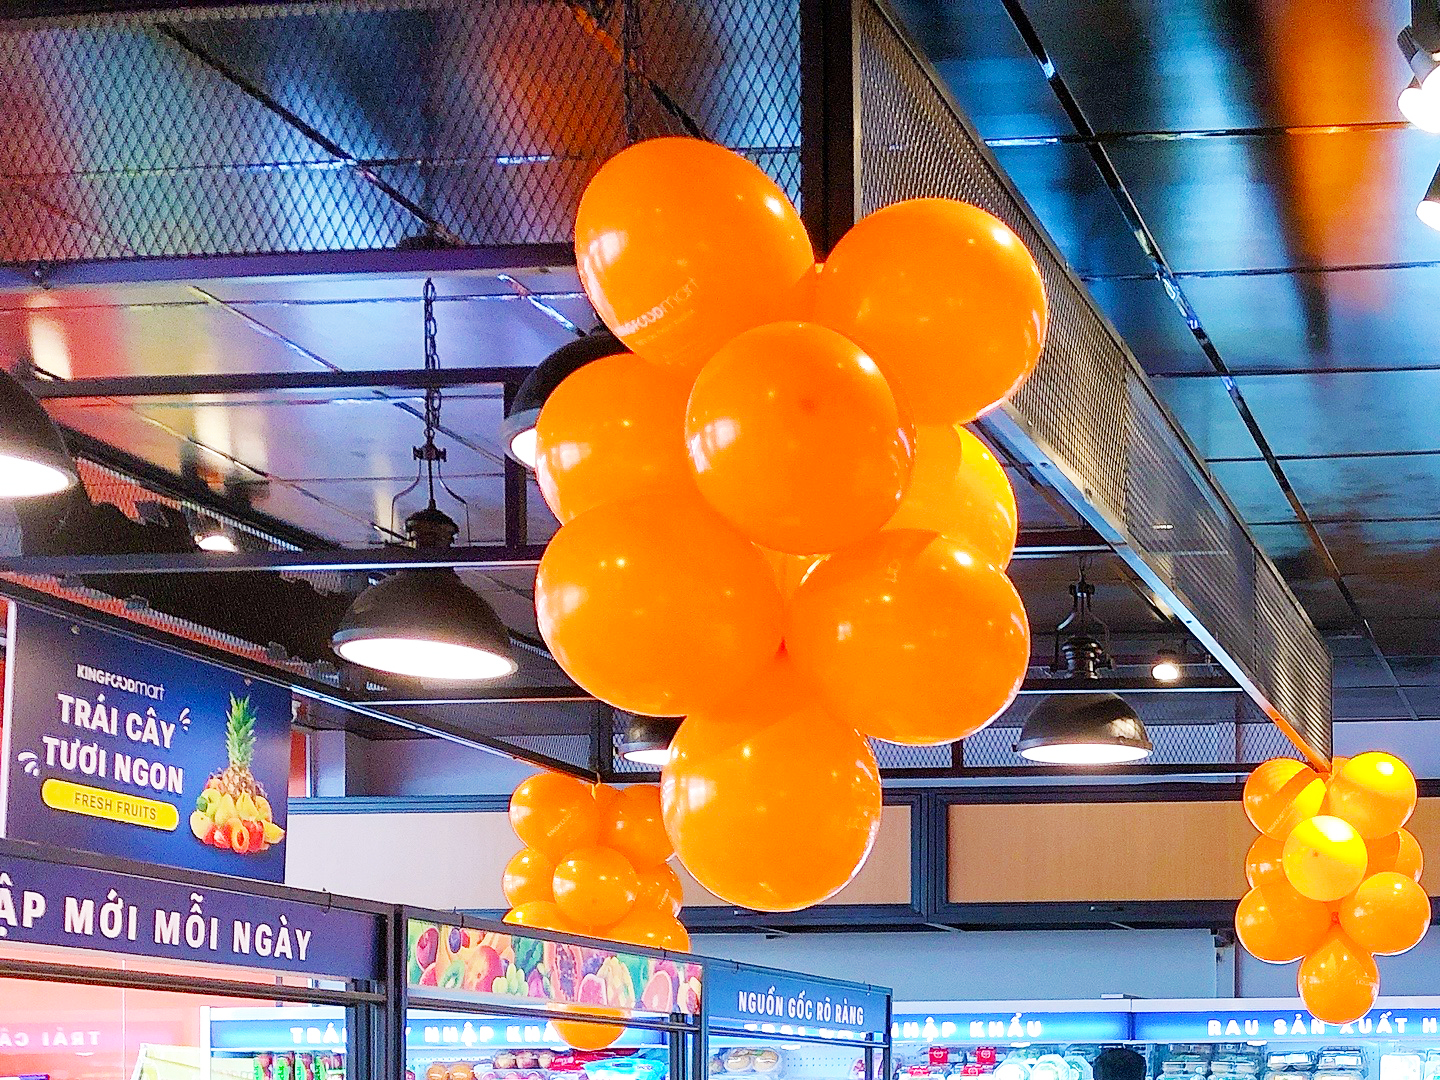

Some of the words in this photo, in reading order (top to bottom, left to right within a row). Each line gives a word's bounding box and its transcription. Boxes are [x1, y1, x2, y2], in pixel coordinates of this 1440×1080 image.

[58, 693, 118, 736] TRÁI
[125, 706, 176, 749] CÂY
[42, 735, 106, 778] TƯƠI
[114, 753, 183, 794] NGON
[74, 791, 113, 812] FRESH
[116, 800, 157, 821] FRUITS
[0, 872, 46, 938] ẬP
[64, 889, 138, 941] MỚI
[154, 892, 218, 950] MỖI
[232, 915, 312, 960] NGÀY
[738, 986, 784, 1017] NGUỒN
[788, 990, 813, 1020] GỐC
[834, 998, 864, 1026] RÀNG
[1207, 1019, 1259, 1036] RAU
[1273, 1013, 1325, 1035] SẢN
